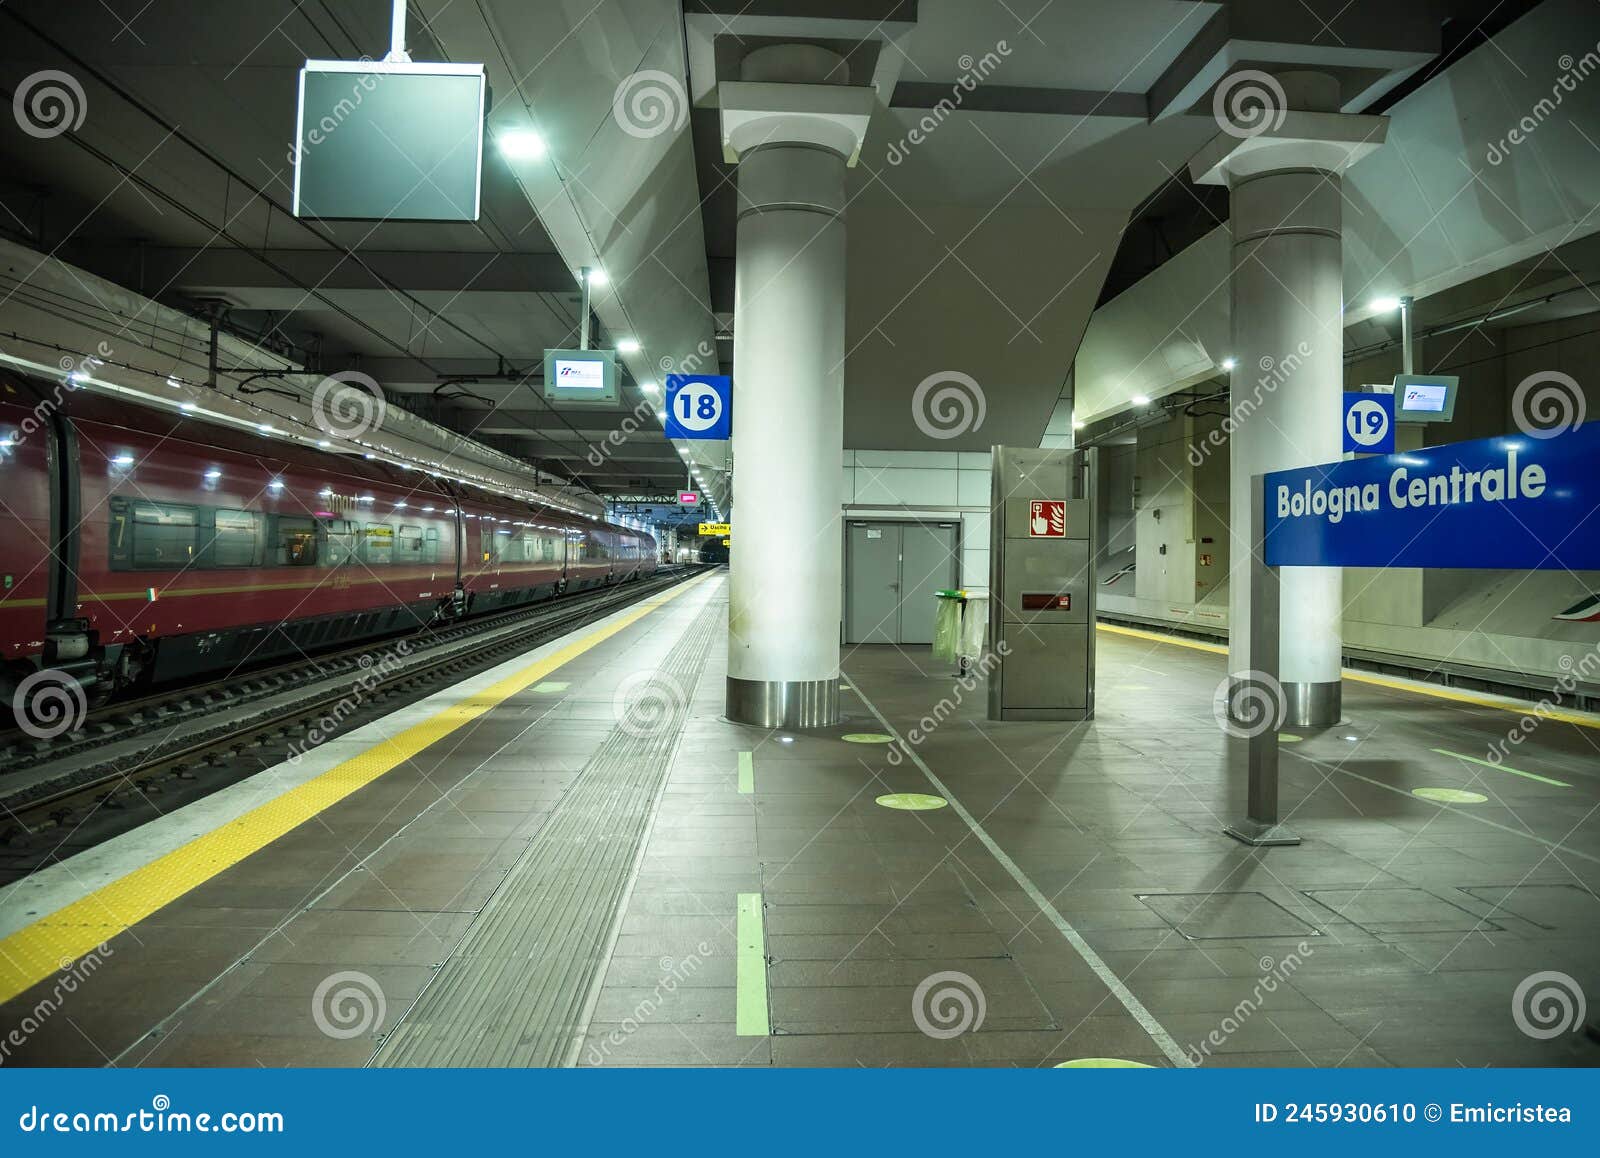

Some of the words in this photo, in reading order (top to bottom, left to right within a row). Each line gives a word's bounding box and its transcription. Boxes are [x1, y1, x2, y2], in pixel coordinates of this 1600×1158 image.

[680, 394, 716, 419] 18
[1352, 411, 1384, 434] 19
[1277, 480, 1380, 524] Bologna
[1388, 450, 1547, 508] Centrale
